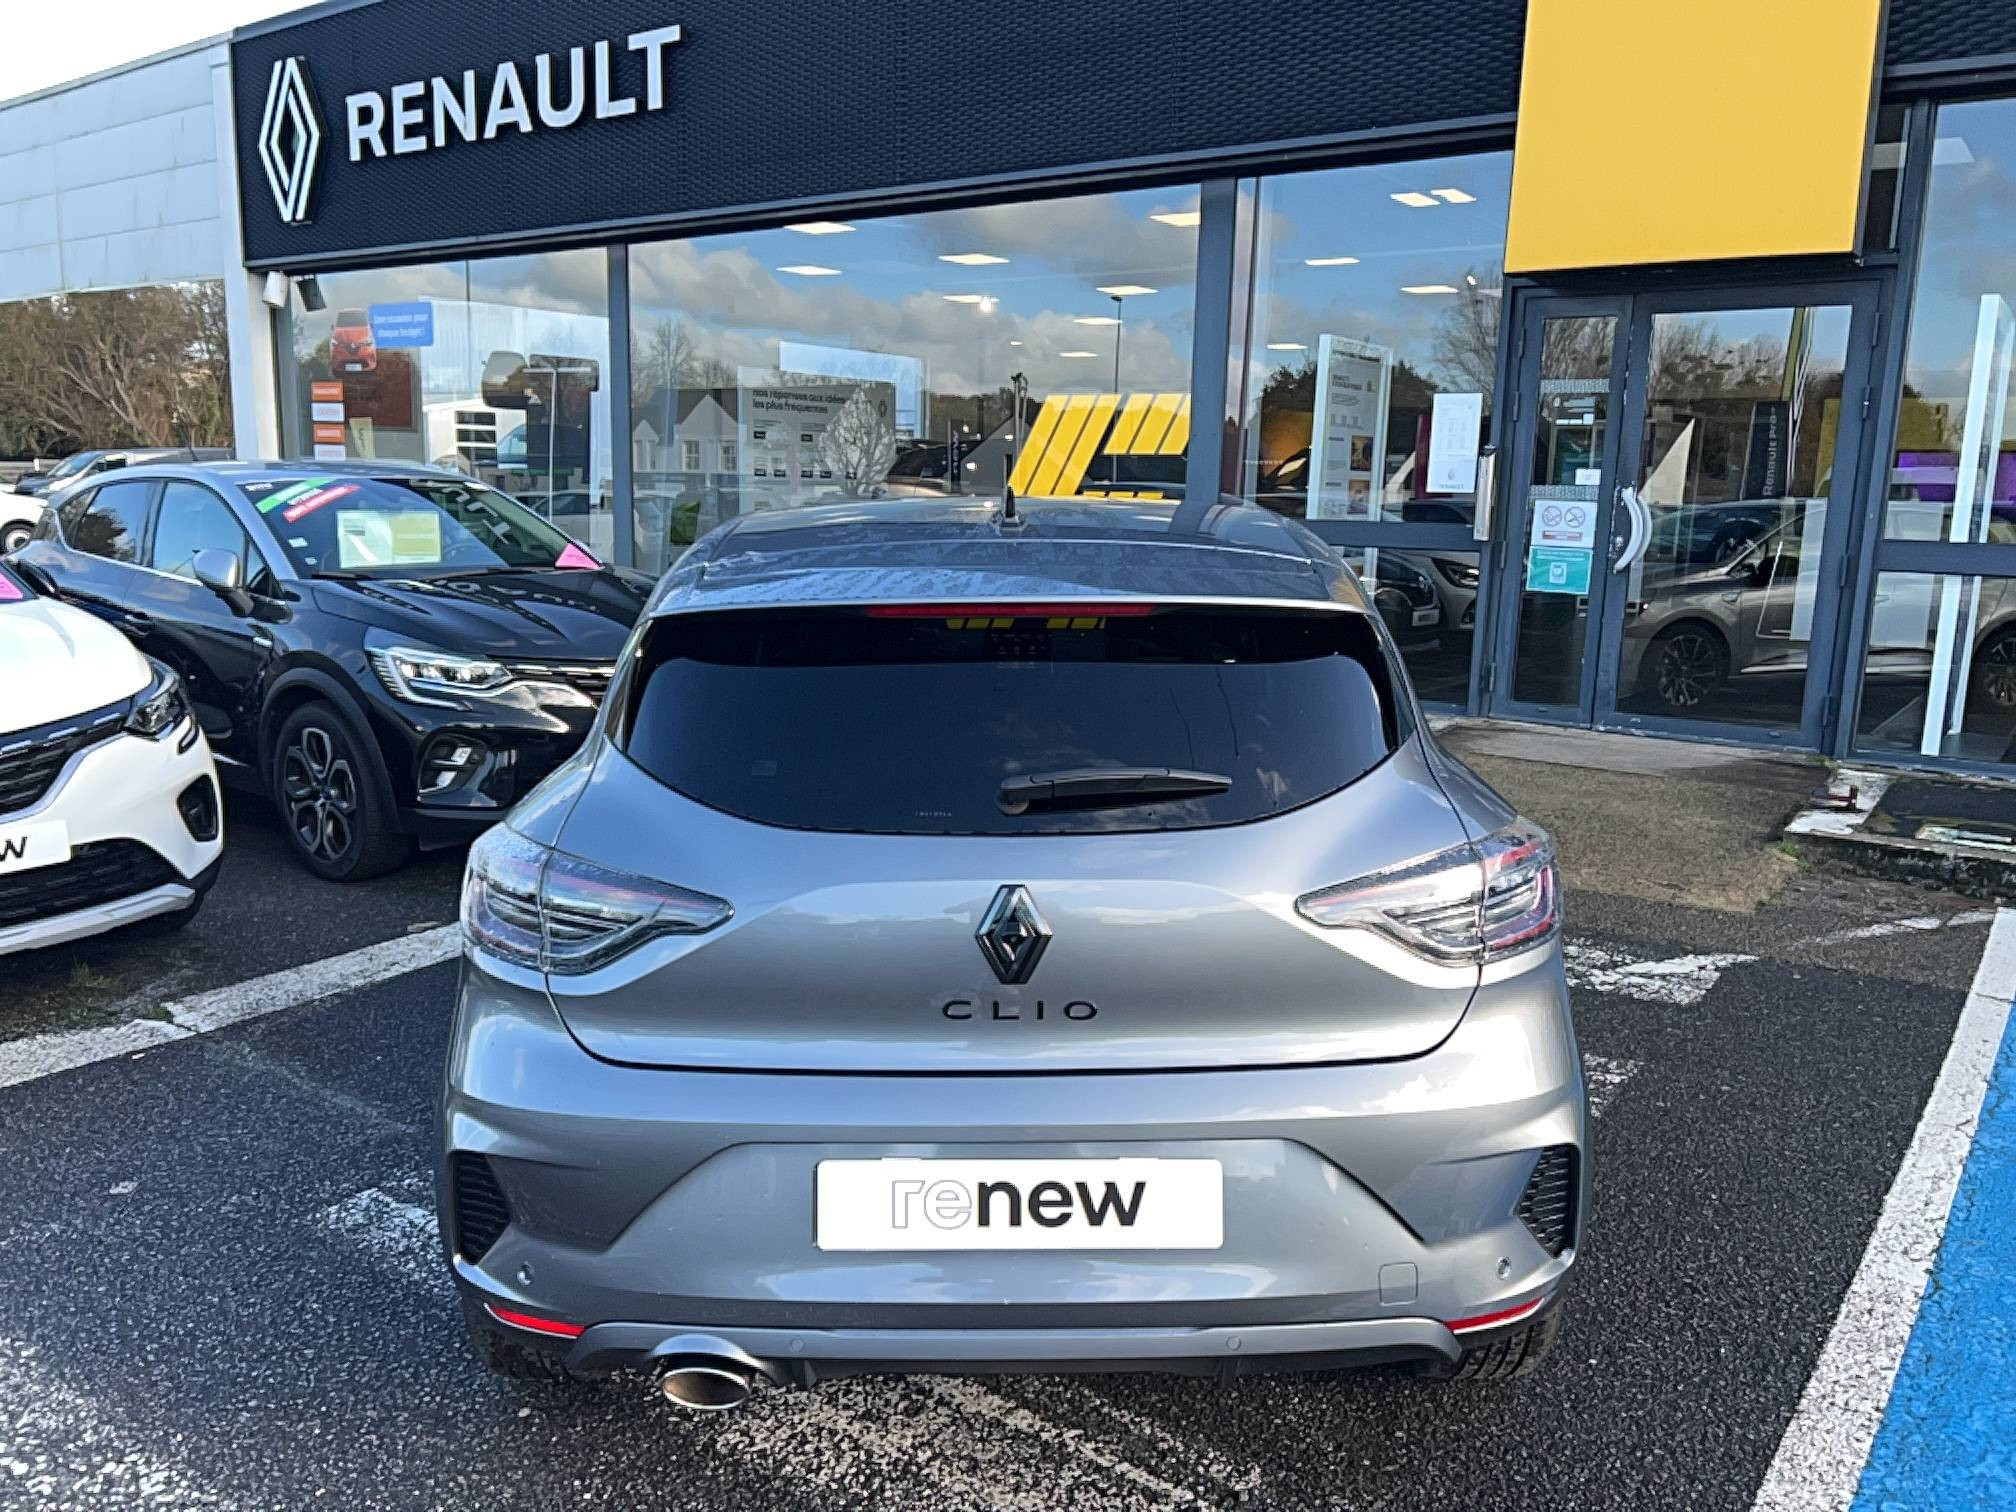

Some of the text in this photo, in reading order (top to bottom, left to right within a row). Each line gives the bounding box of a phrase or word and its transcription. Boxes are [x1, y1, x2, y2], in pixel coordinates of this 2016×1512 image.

[345, 24, 682, 162] RENAULT
[765, 400, 784, 412] plus
[1762, 441, 1778, 497] Renault
[941, 1000, 1099, 1021] CLIO
[891, 1178, 1147, 1231] renew
